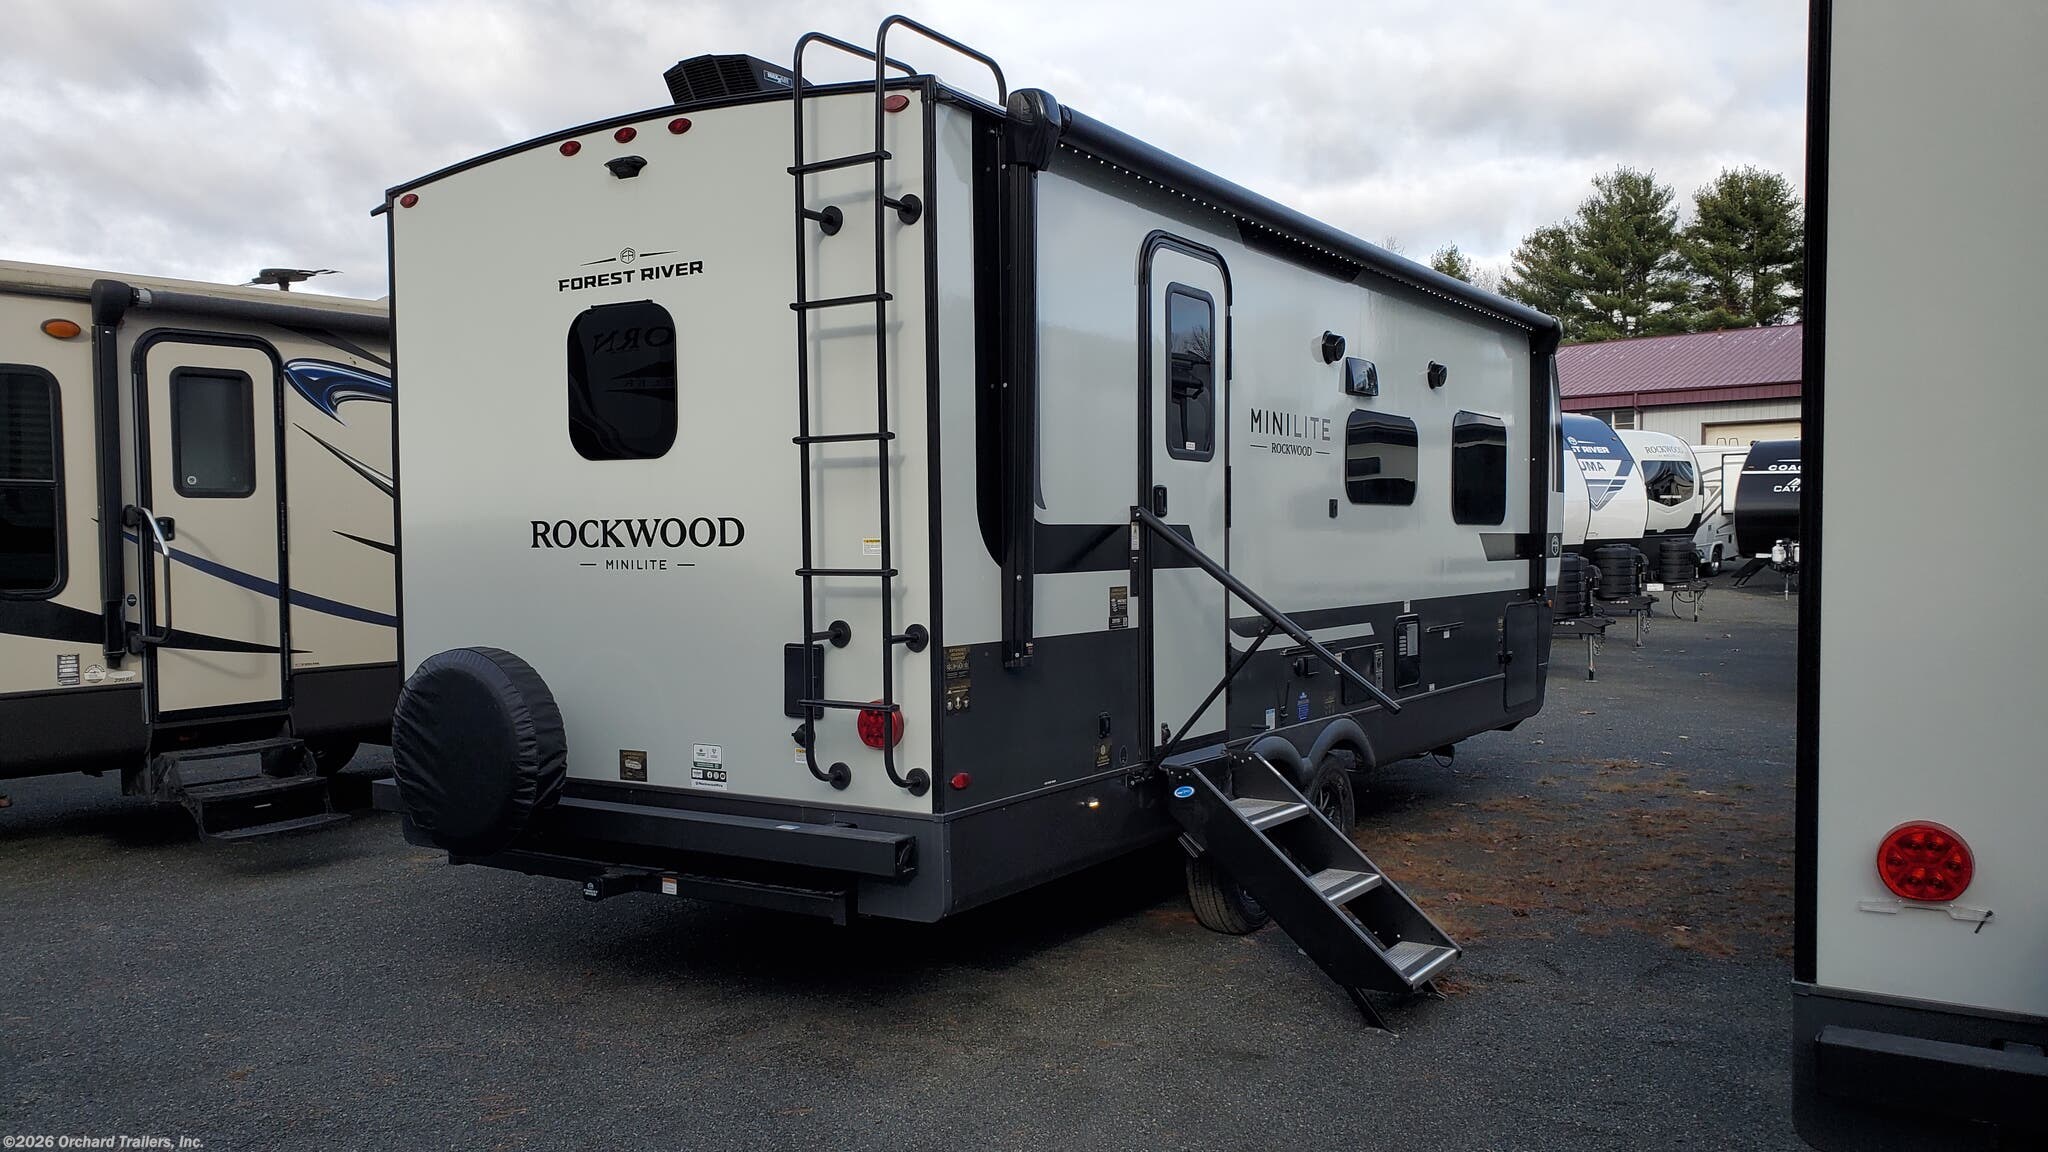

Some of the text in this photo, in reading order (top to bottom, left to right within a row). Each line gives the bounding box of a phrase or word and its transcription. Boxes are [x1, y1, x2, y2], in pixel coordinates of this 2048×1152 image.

[558, 260, 704, 292] FOREST RIVER
[1250, 408, 1331, 441] MINILITE
[1271, 442, 1312, 457] ROCKWOOD
[1581, 445, 1610, 454] RIVER
[530, 517, 745, 549] ROCKWOOD
[605, 559, 668, 570] MINILITE
